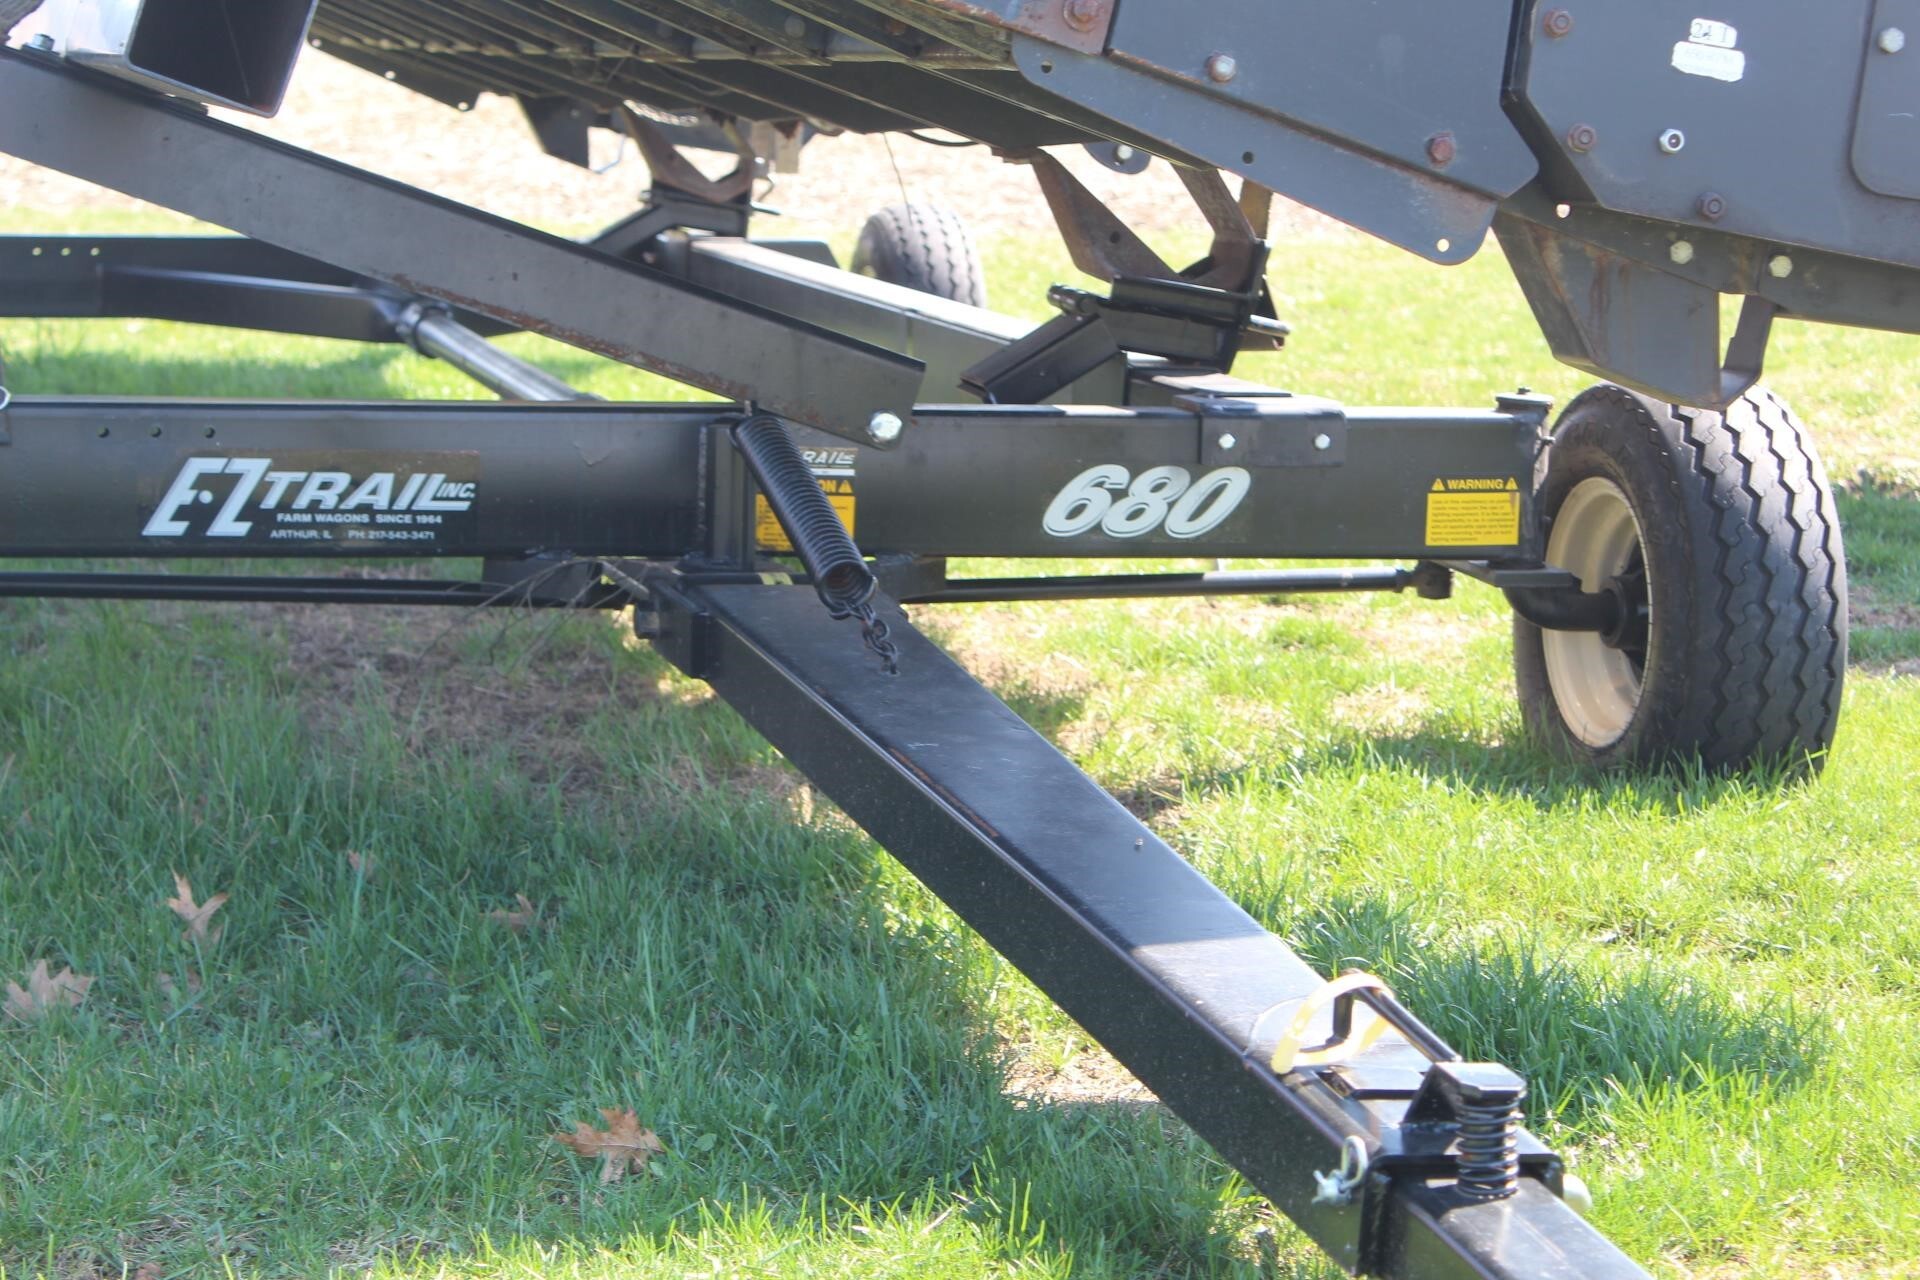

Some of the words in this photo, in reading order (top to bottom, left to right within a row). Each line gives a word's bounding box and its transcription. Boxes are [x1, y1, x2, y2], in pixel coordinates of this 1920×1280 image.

[801, 450, 854, 465] RAIL
[259, 471, 471, 512] TRAIL
[1446, 478, 1504, 490] WARNING
[1042, 463, 1251, 538] 680
[276, 512, 312, 523] FARM
[314, 513, 370, 523] WAGONS
[375, 513, 413, 524] SINCE
